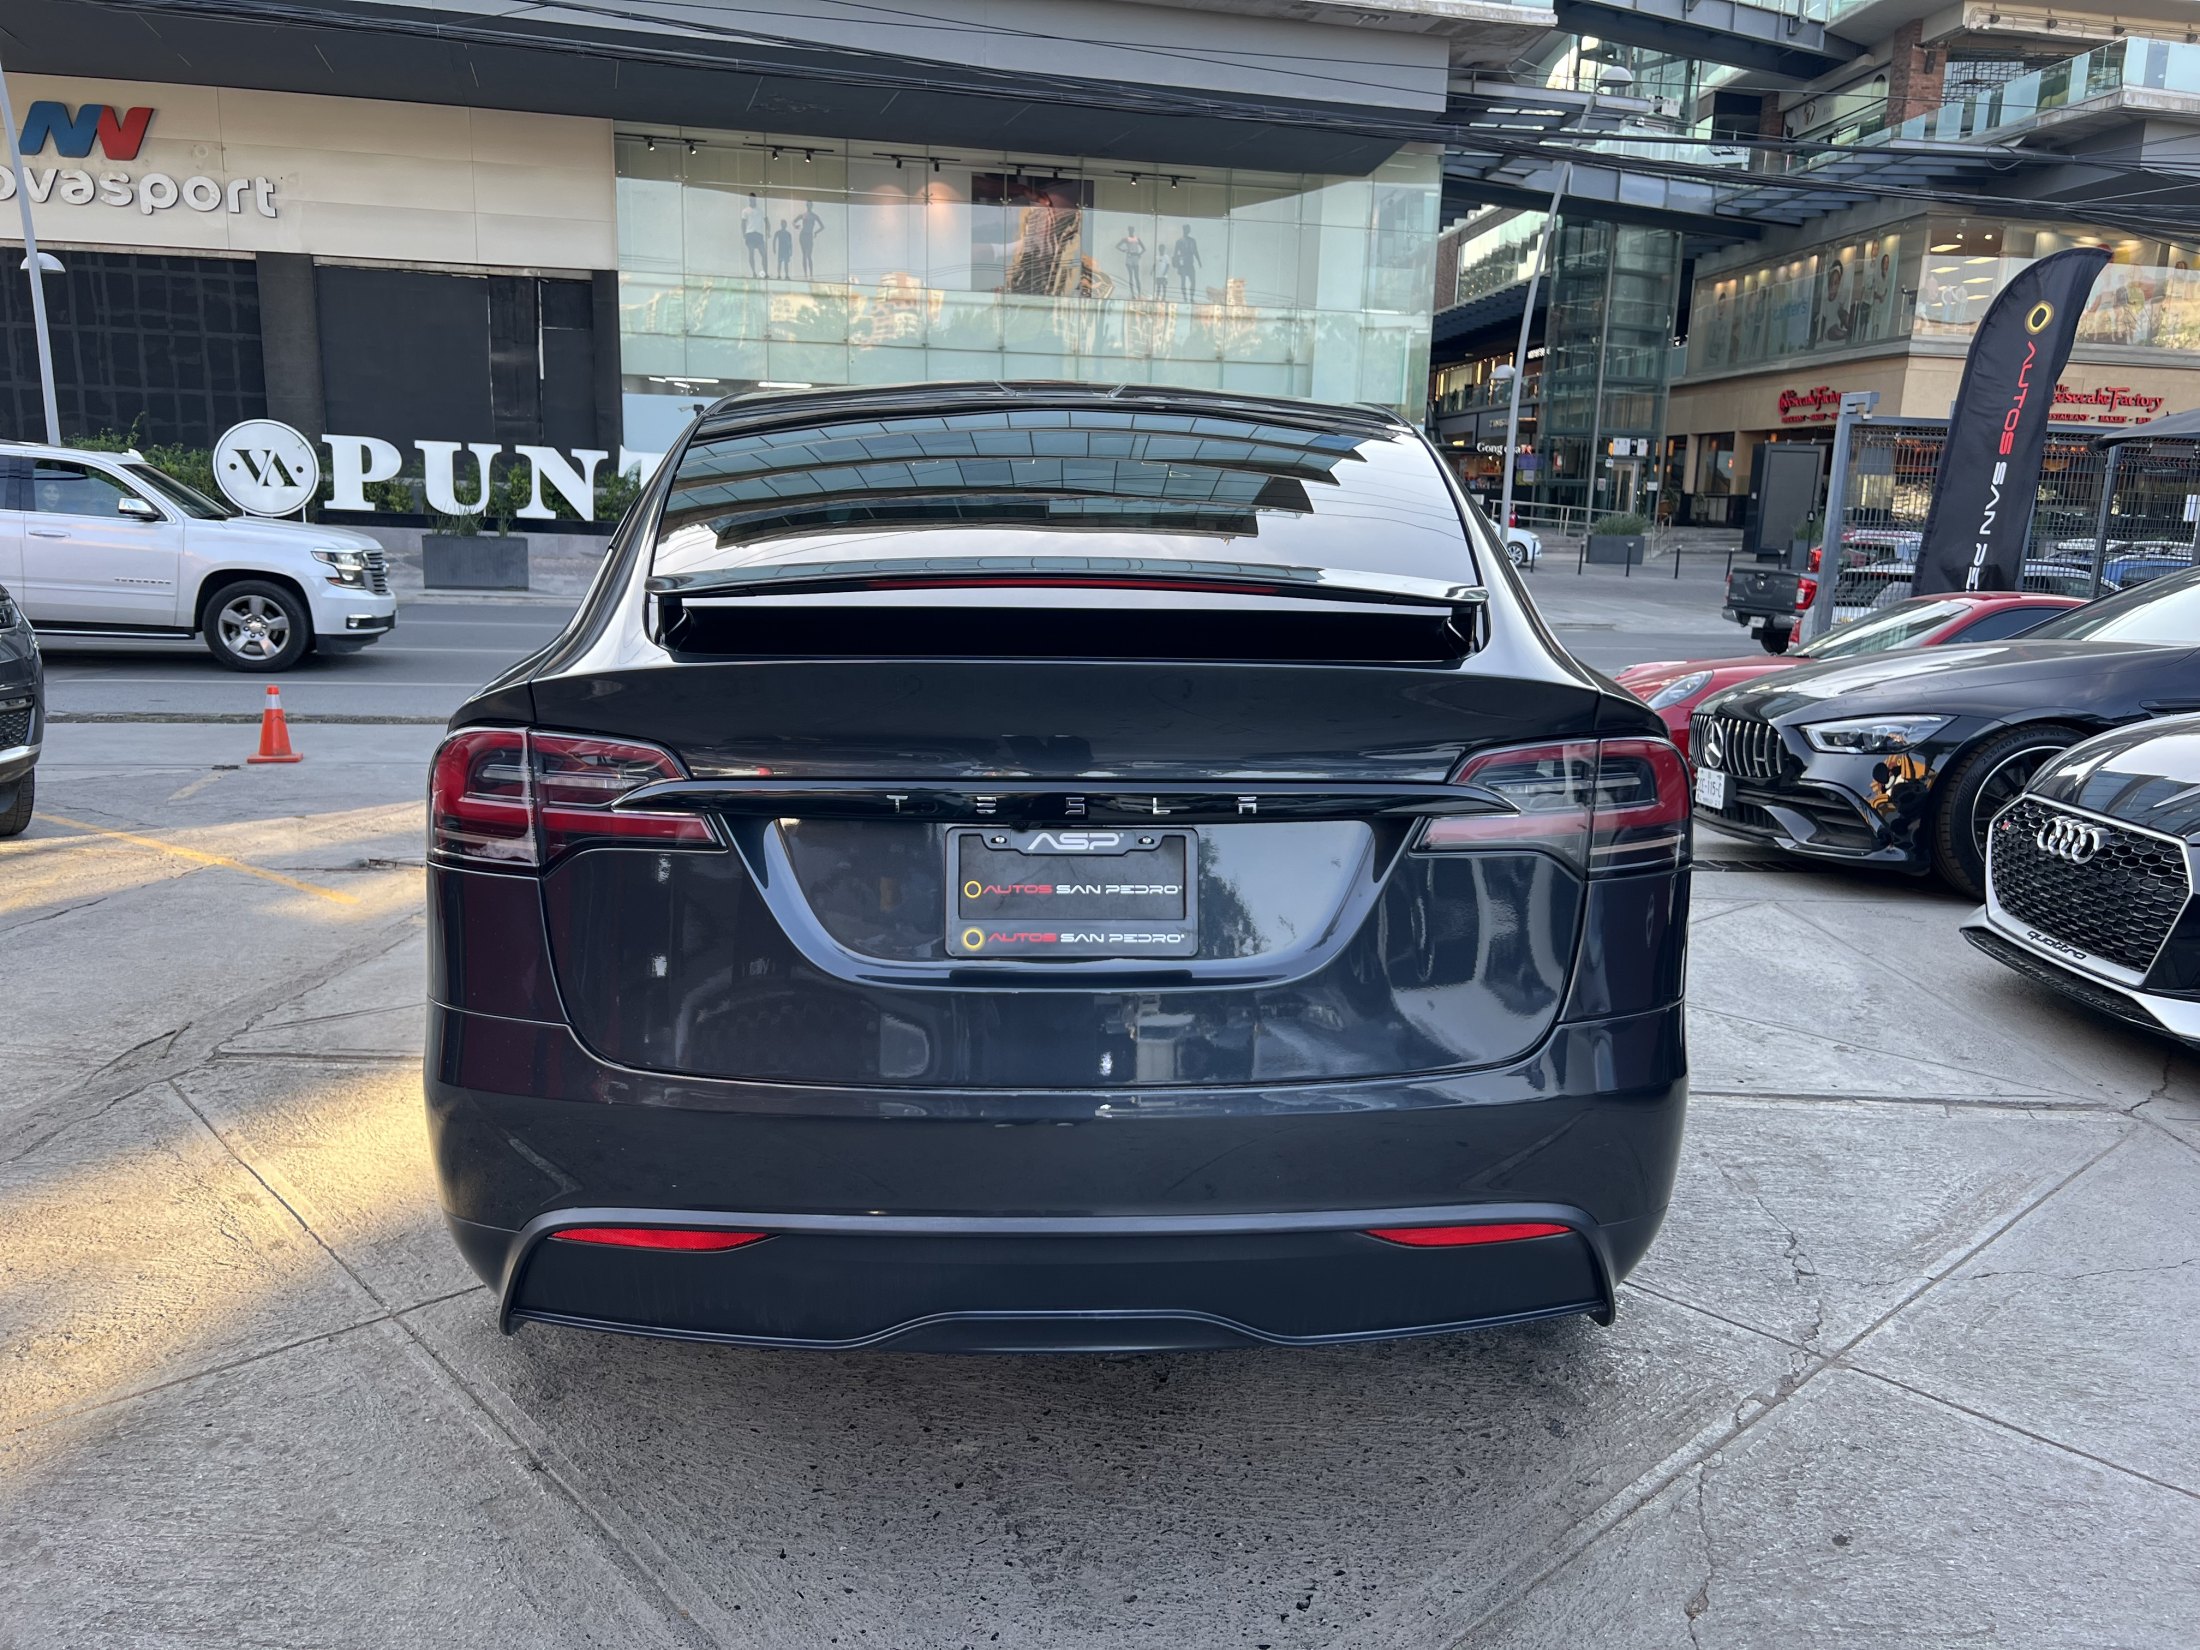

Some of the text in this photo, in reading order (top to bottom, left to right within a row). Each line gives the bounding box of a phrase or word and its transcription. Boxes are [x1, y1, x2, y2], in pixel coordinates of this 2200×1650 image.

[1999, 340, 2037, 455] AUTOS
[2105, 387, 2164, 413] Factory
[1476, 442, 1503, 456] Gong
[1979, 461, 2007, 535] SAN
[886, 794, 1257, 815] TESLA
[1027, 832, 1120, 850] ASP
[982, 884, 1179, 894] AUTOS SAN PEDRO
[988, 932, 1181, 943] AUTOS SAN PEDRO
[2026, 930, 2087, 960] quattro
